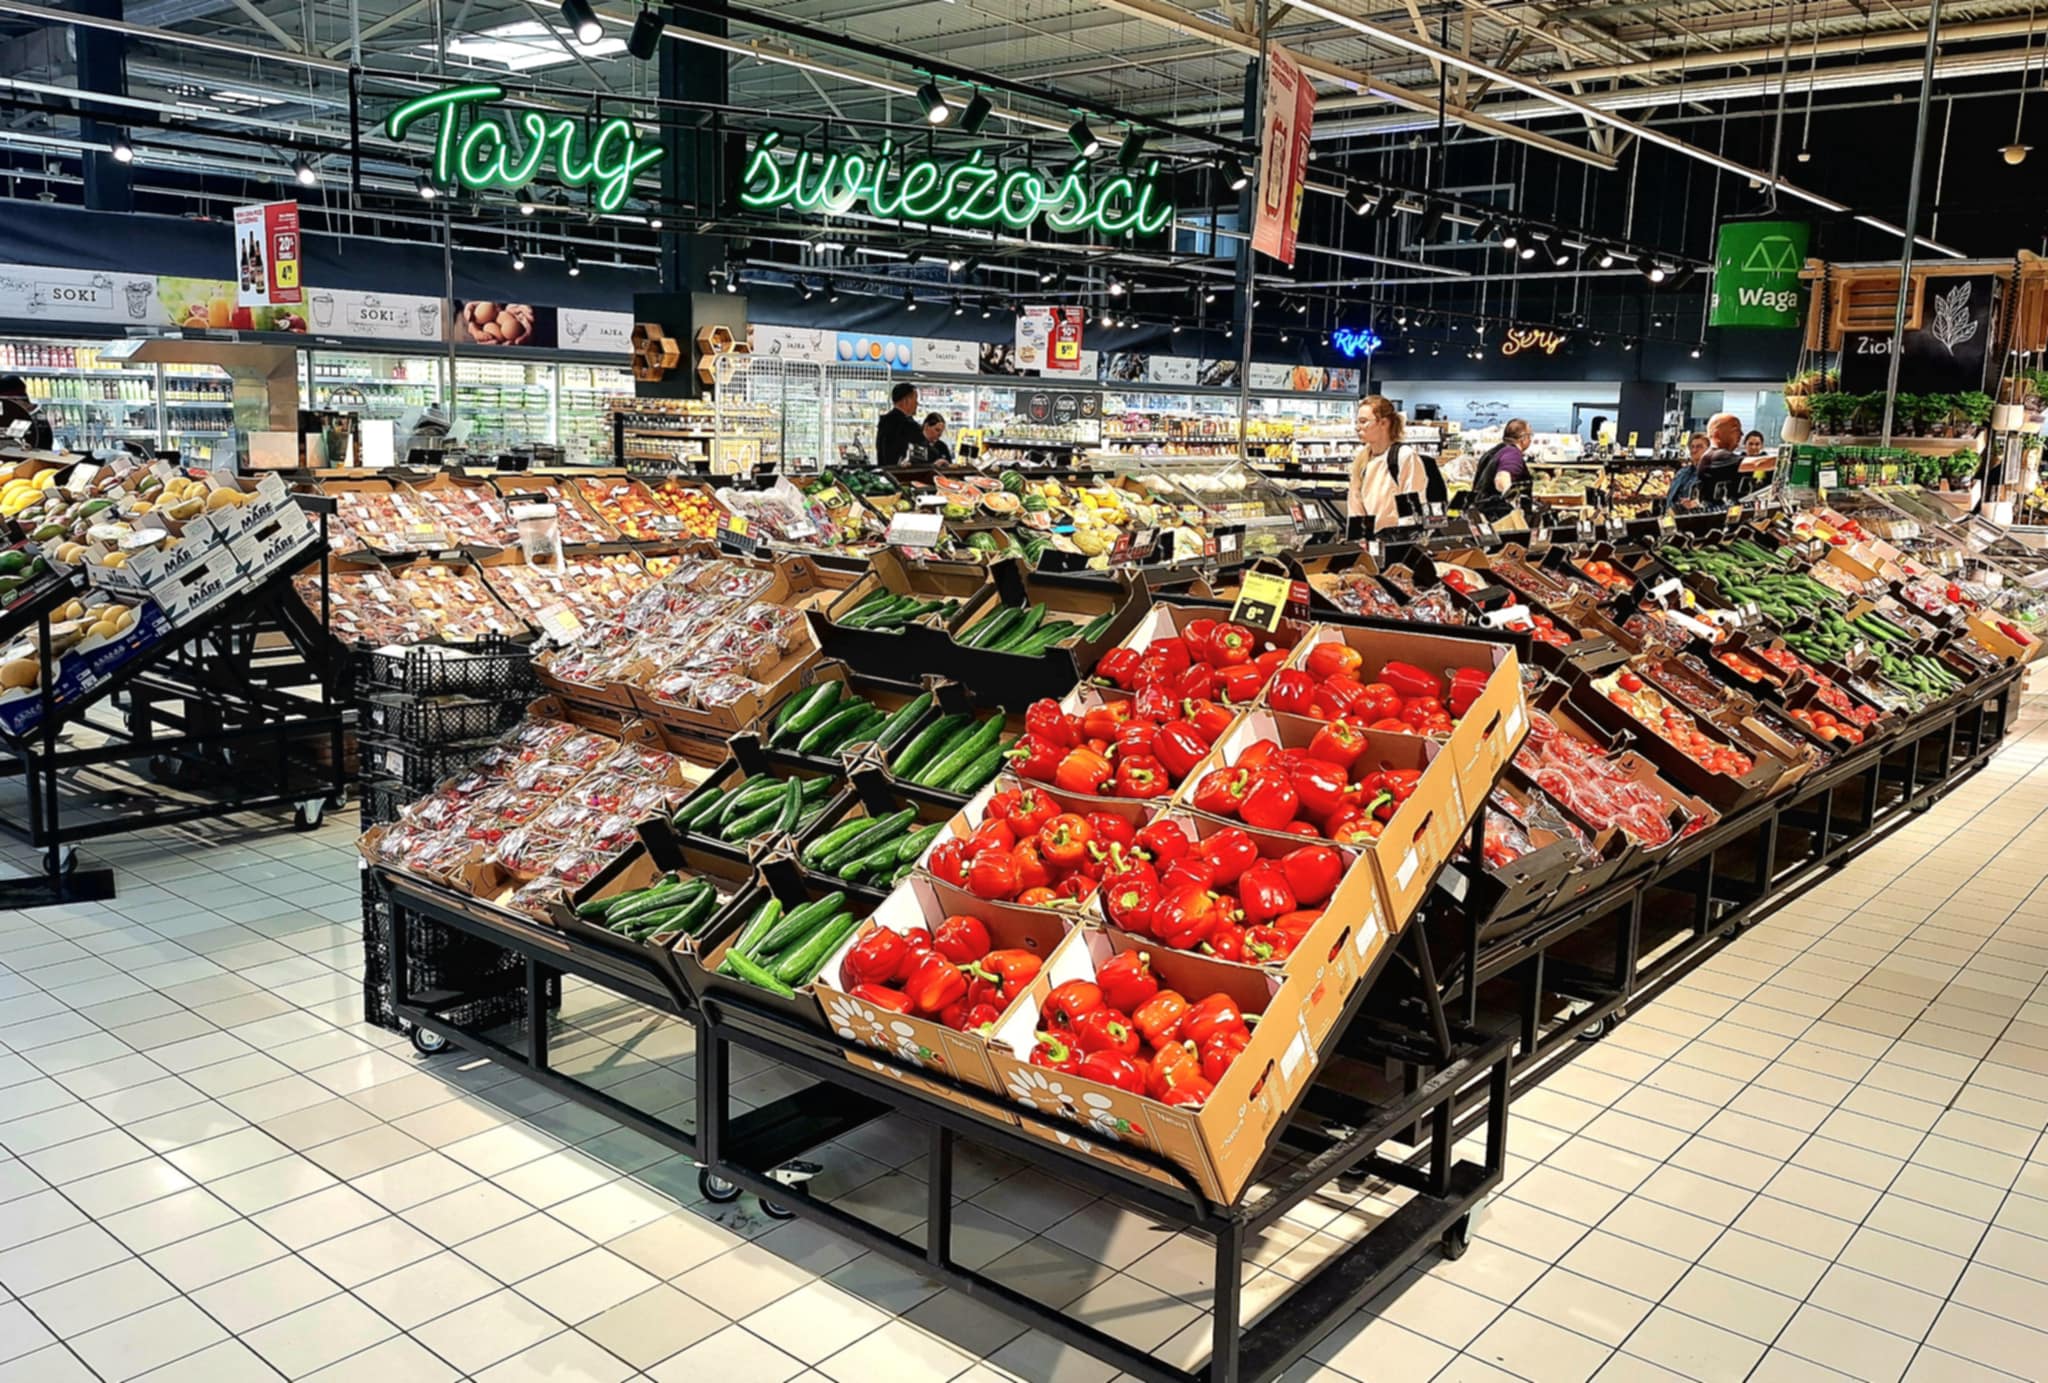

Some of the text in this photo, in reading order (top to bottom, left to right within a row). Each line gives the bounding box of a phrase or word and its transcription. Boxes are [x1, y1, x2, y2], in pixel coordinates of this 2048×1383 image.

[388, 84, 664, 212] Targ
[741, 130, 1175, 236] świeżości
[52, 288, 97, 302] SOKI
[1738, 287, 1798, 312] Waga
[359, 309, 395, 321] SOKI
[1502, 327, 1565, 355] Sery
